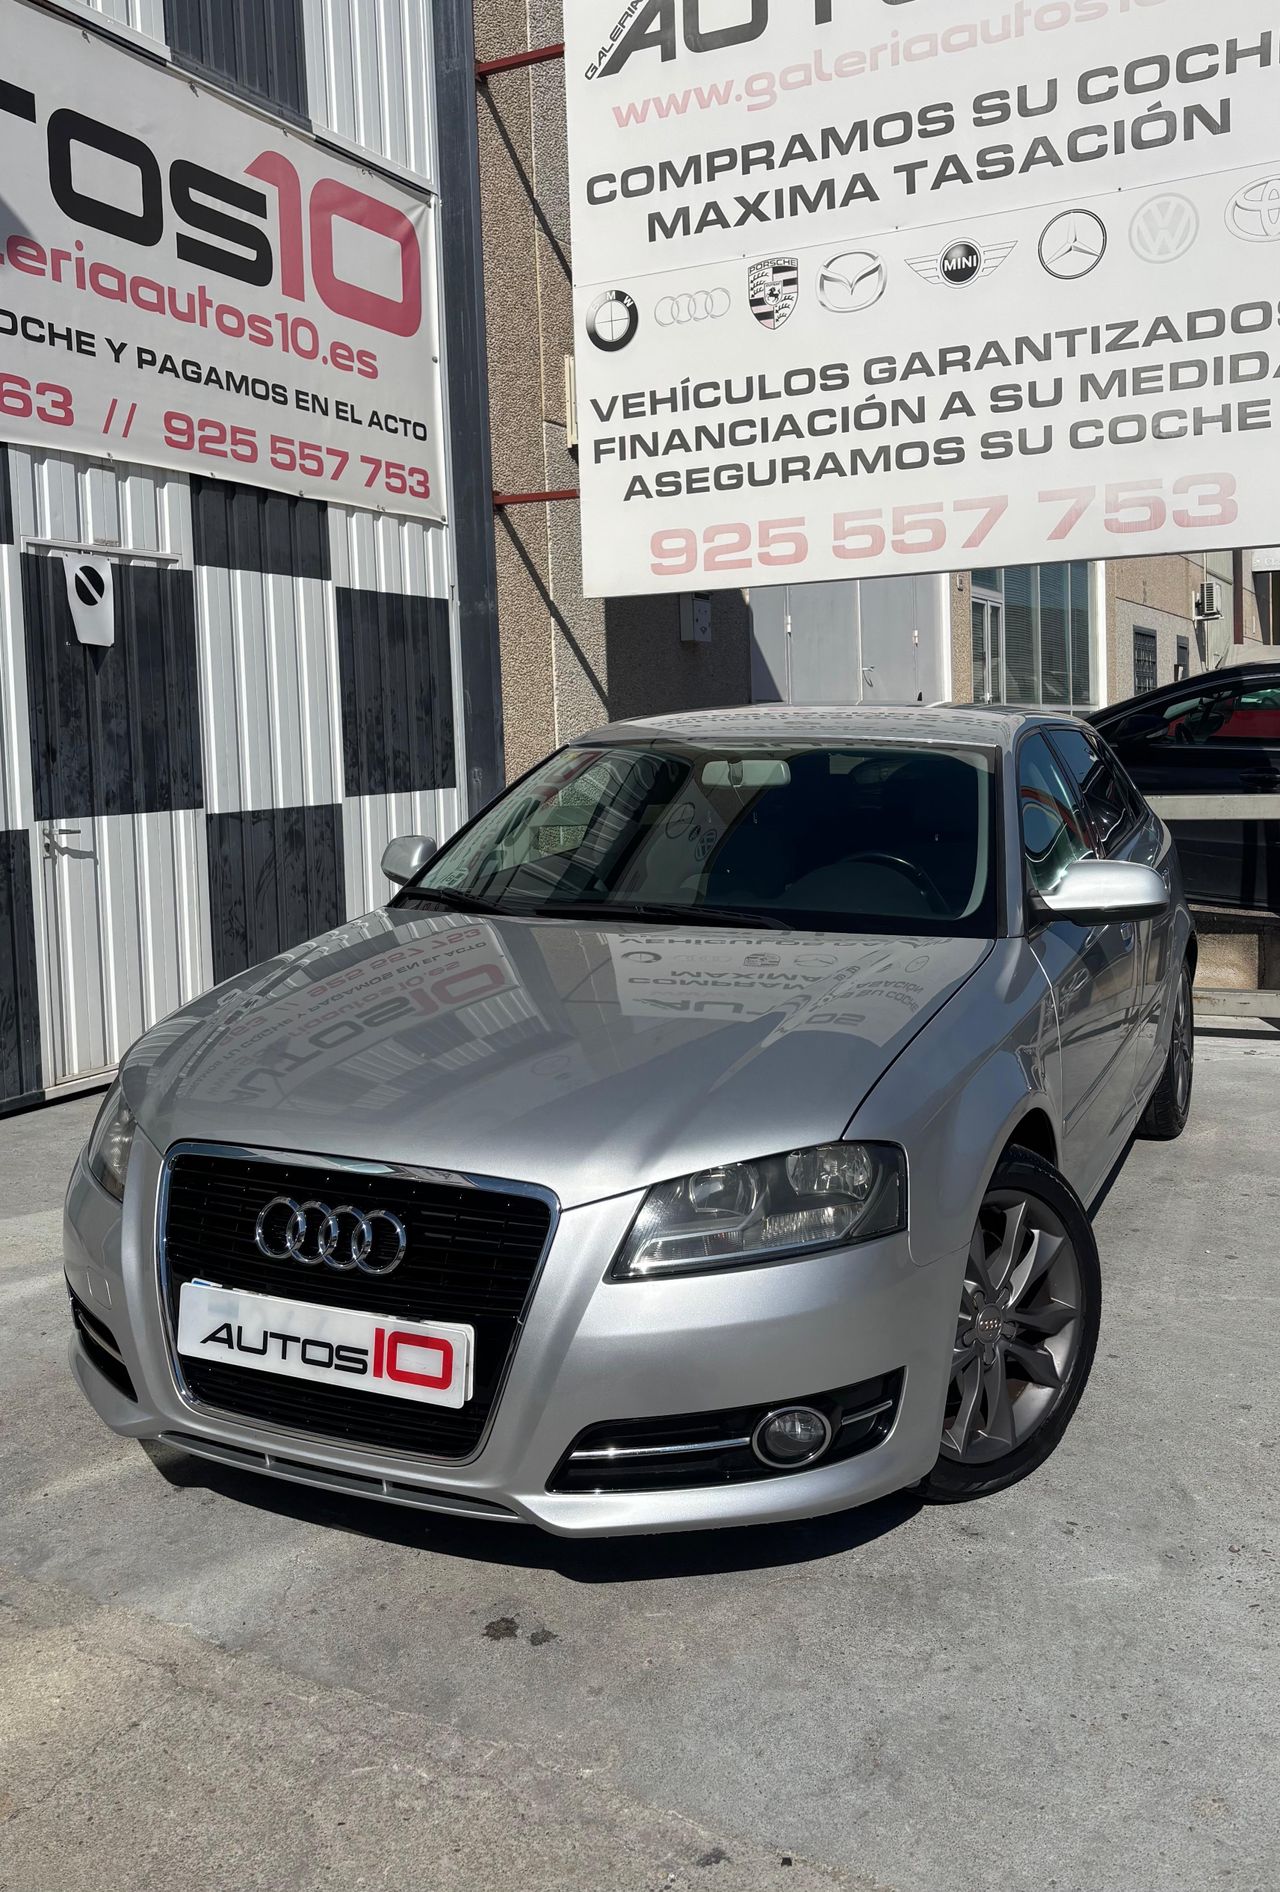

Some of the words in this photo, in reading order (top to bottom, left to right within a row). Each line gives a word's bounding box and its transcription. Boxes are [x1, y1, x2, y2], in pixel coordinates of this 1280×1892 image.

[586, 102, 955, 205] COMPRAMOS
[973, 78, 1058, 127] SU
[1077, 30, 1280, 105] COCH
[647, 172, 881, 242] MAXIMA
[893, 97, 1231, 195] TASACIÓN
[749, 259, 798, 274] PORSCHE
[943, 254, 977, 272] MINI
[104, 337, 128, 363] Y
[137, 346, 288, 406] PAGAMOS
[295, 389, 330, 417] EN
[335, 400, 363, 426] EL
[368, 410, 428, 442] ACTO
[590, 363, 850, 423] VEHÍCULOS
[863, 300, 1280, 386] GARANTIZADO
[593, 394, 925, 464] FINANCIACIÓN
[939, 390, 976, 421] A
[989, 377, 1063, 413] SU
[1080, 350, 1280, 403] MEDID
[163, 410, 259, 464] 925
[270, 434, 349, 481] 557
[360, 455, 430, 499] 753
[623, 436, 965, 501] ASEGURAMOS
[980, 425, 1053, 460] SU
[1069, 399, 1272, 450] COCHE
[650, 517, 808, 576] 925
[832, 495, 1009, 560] 557
[1038, 472, 1239, 541] 753
[200, 1322, 454, 1390] AUTOS10
